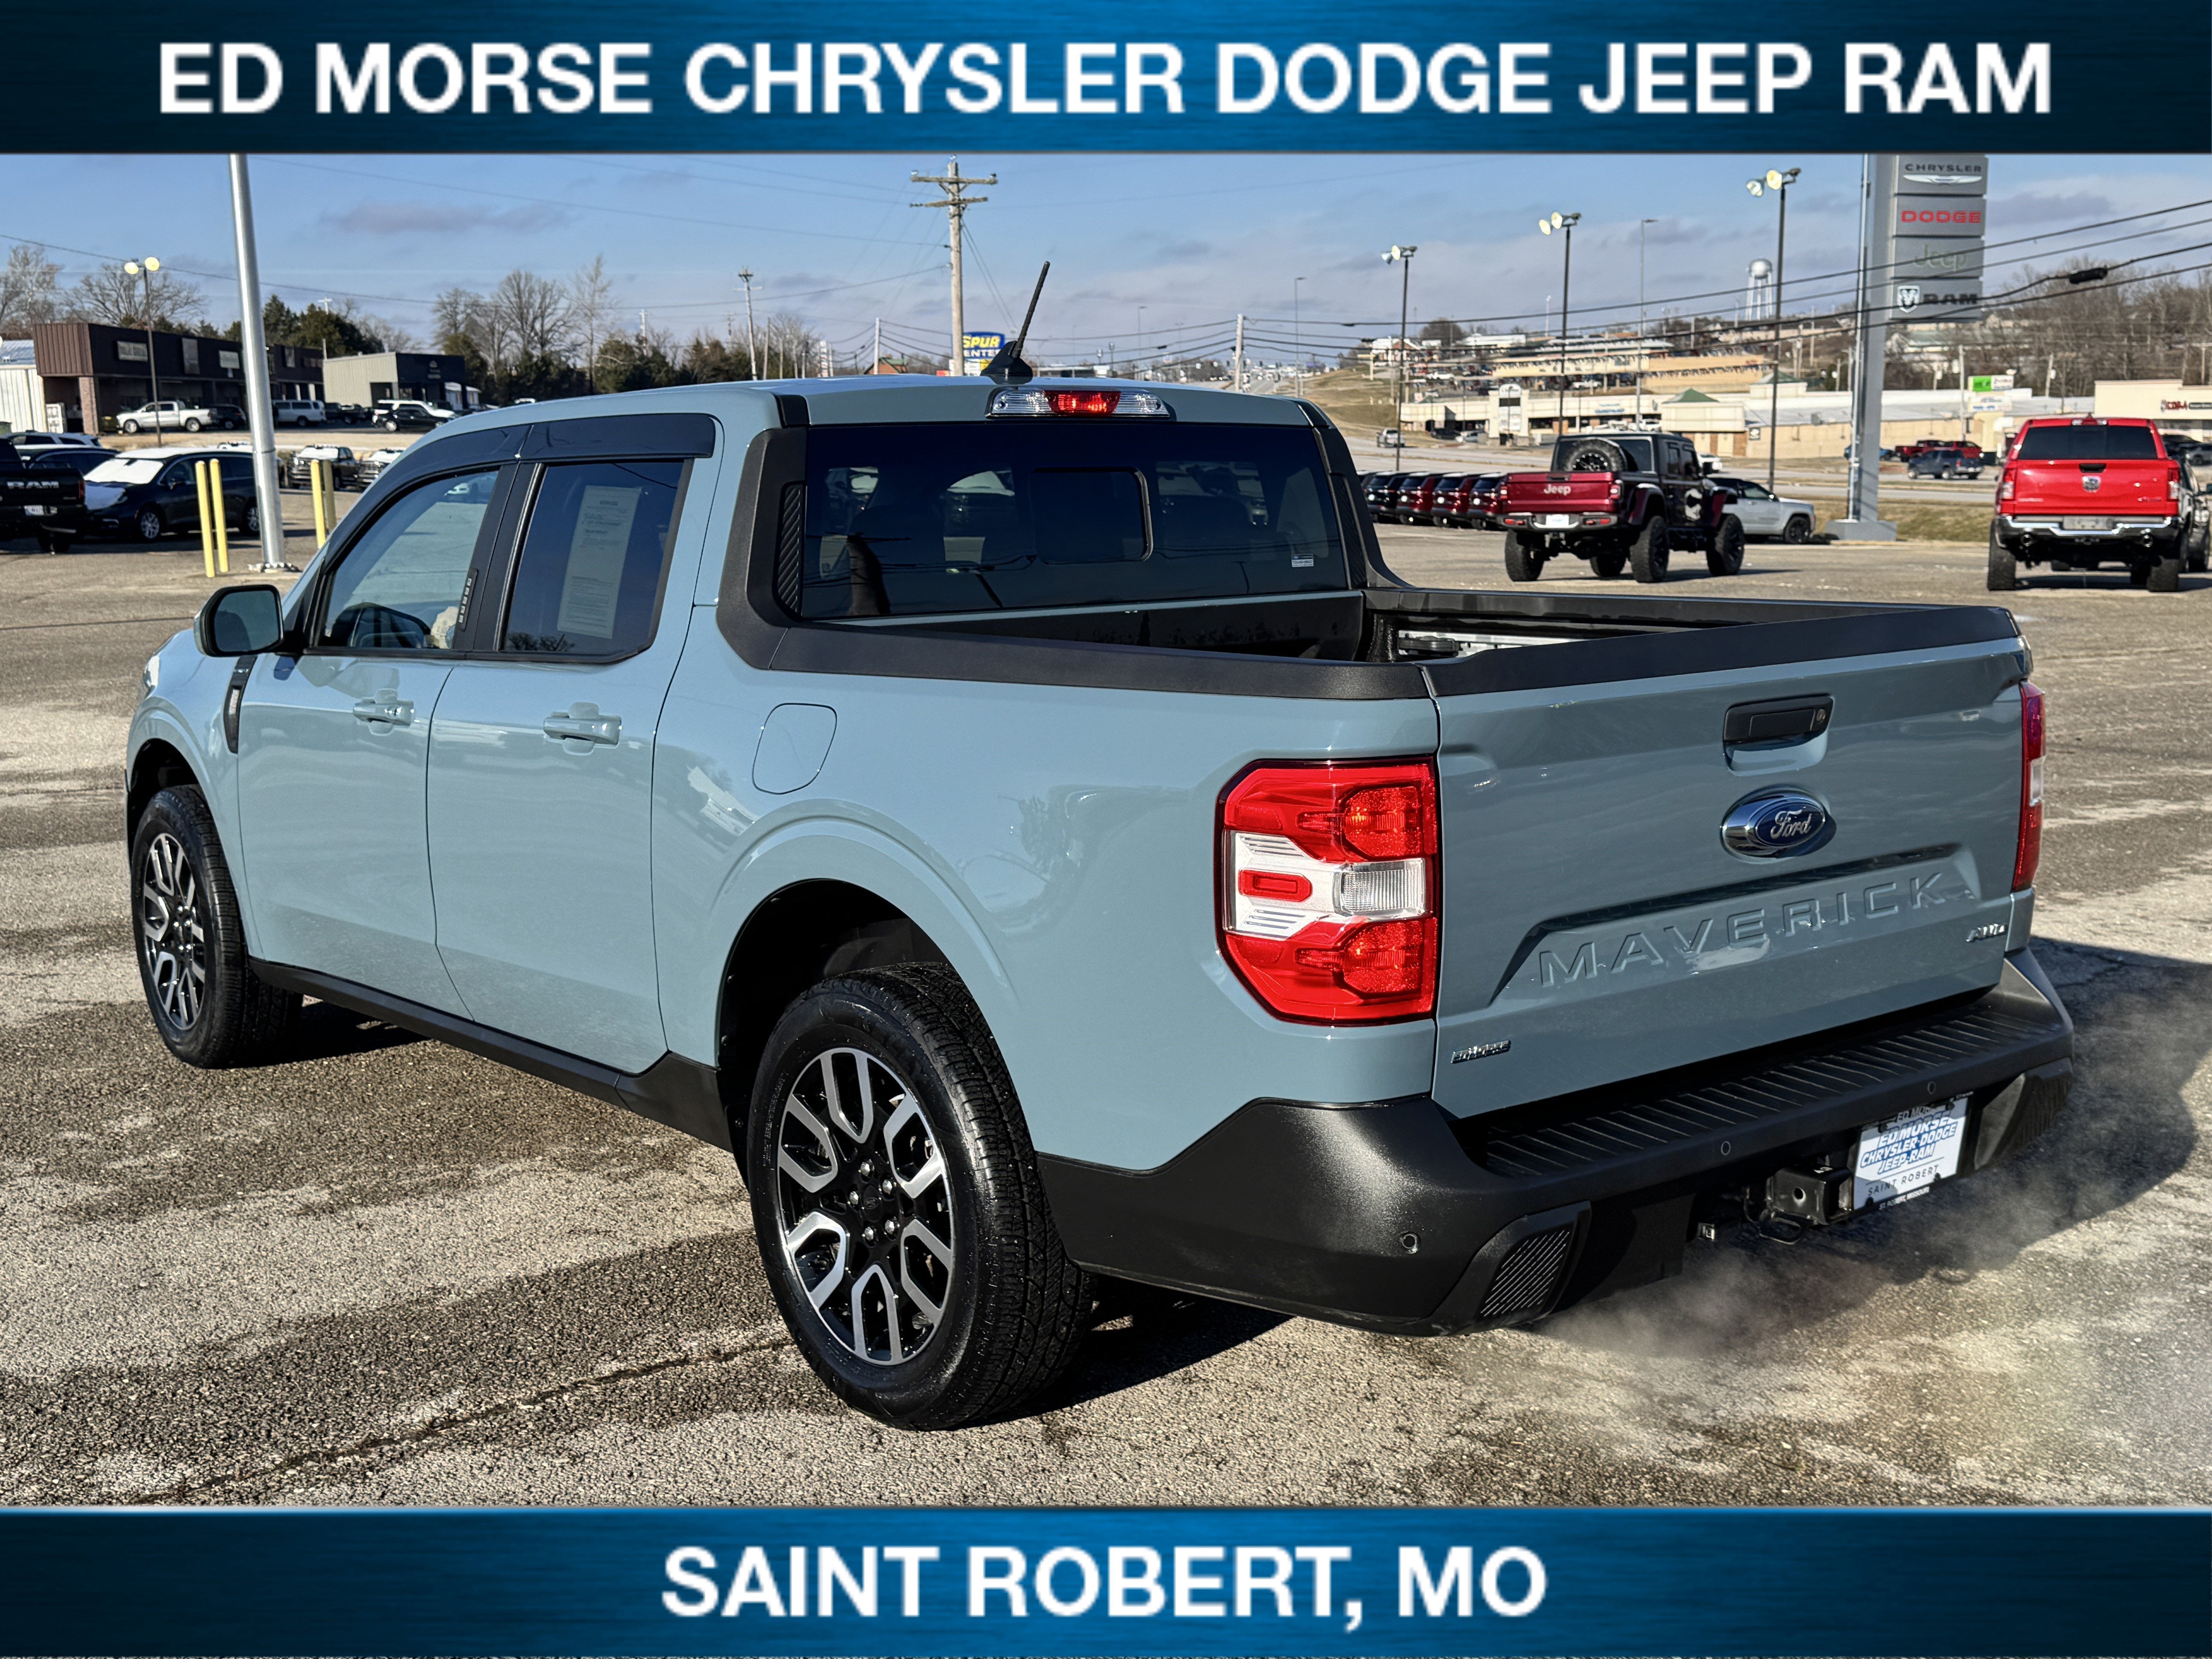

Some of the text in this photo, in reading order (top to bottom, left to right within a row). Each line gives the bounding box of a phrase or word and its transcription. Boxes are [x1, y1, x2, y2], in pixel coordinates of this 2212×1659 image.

[1905, 163, 1982, 172] CHRYSLER
[1901, 210, 1982, 223] DODGE
[1913, 244, 1968, 270] Jeep
[1923, 293, 1978, 305] RAM
[1544, 484, 1571, 496] Jeep
[1770, 809, 1812, 839] Ford
[1539, 872, 1946, 987] MAVERICK
[1868, 1164, 1939, 1196] SAINT ROBERT
